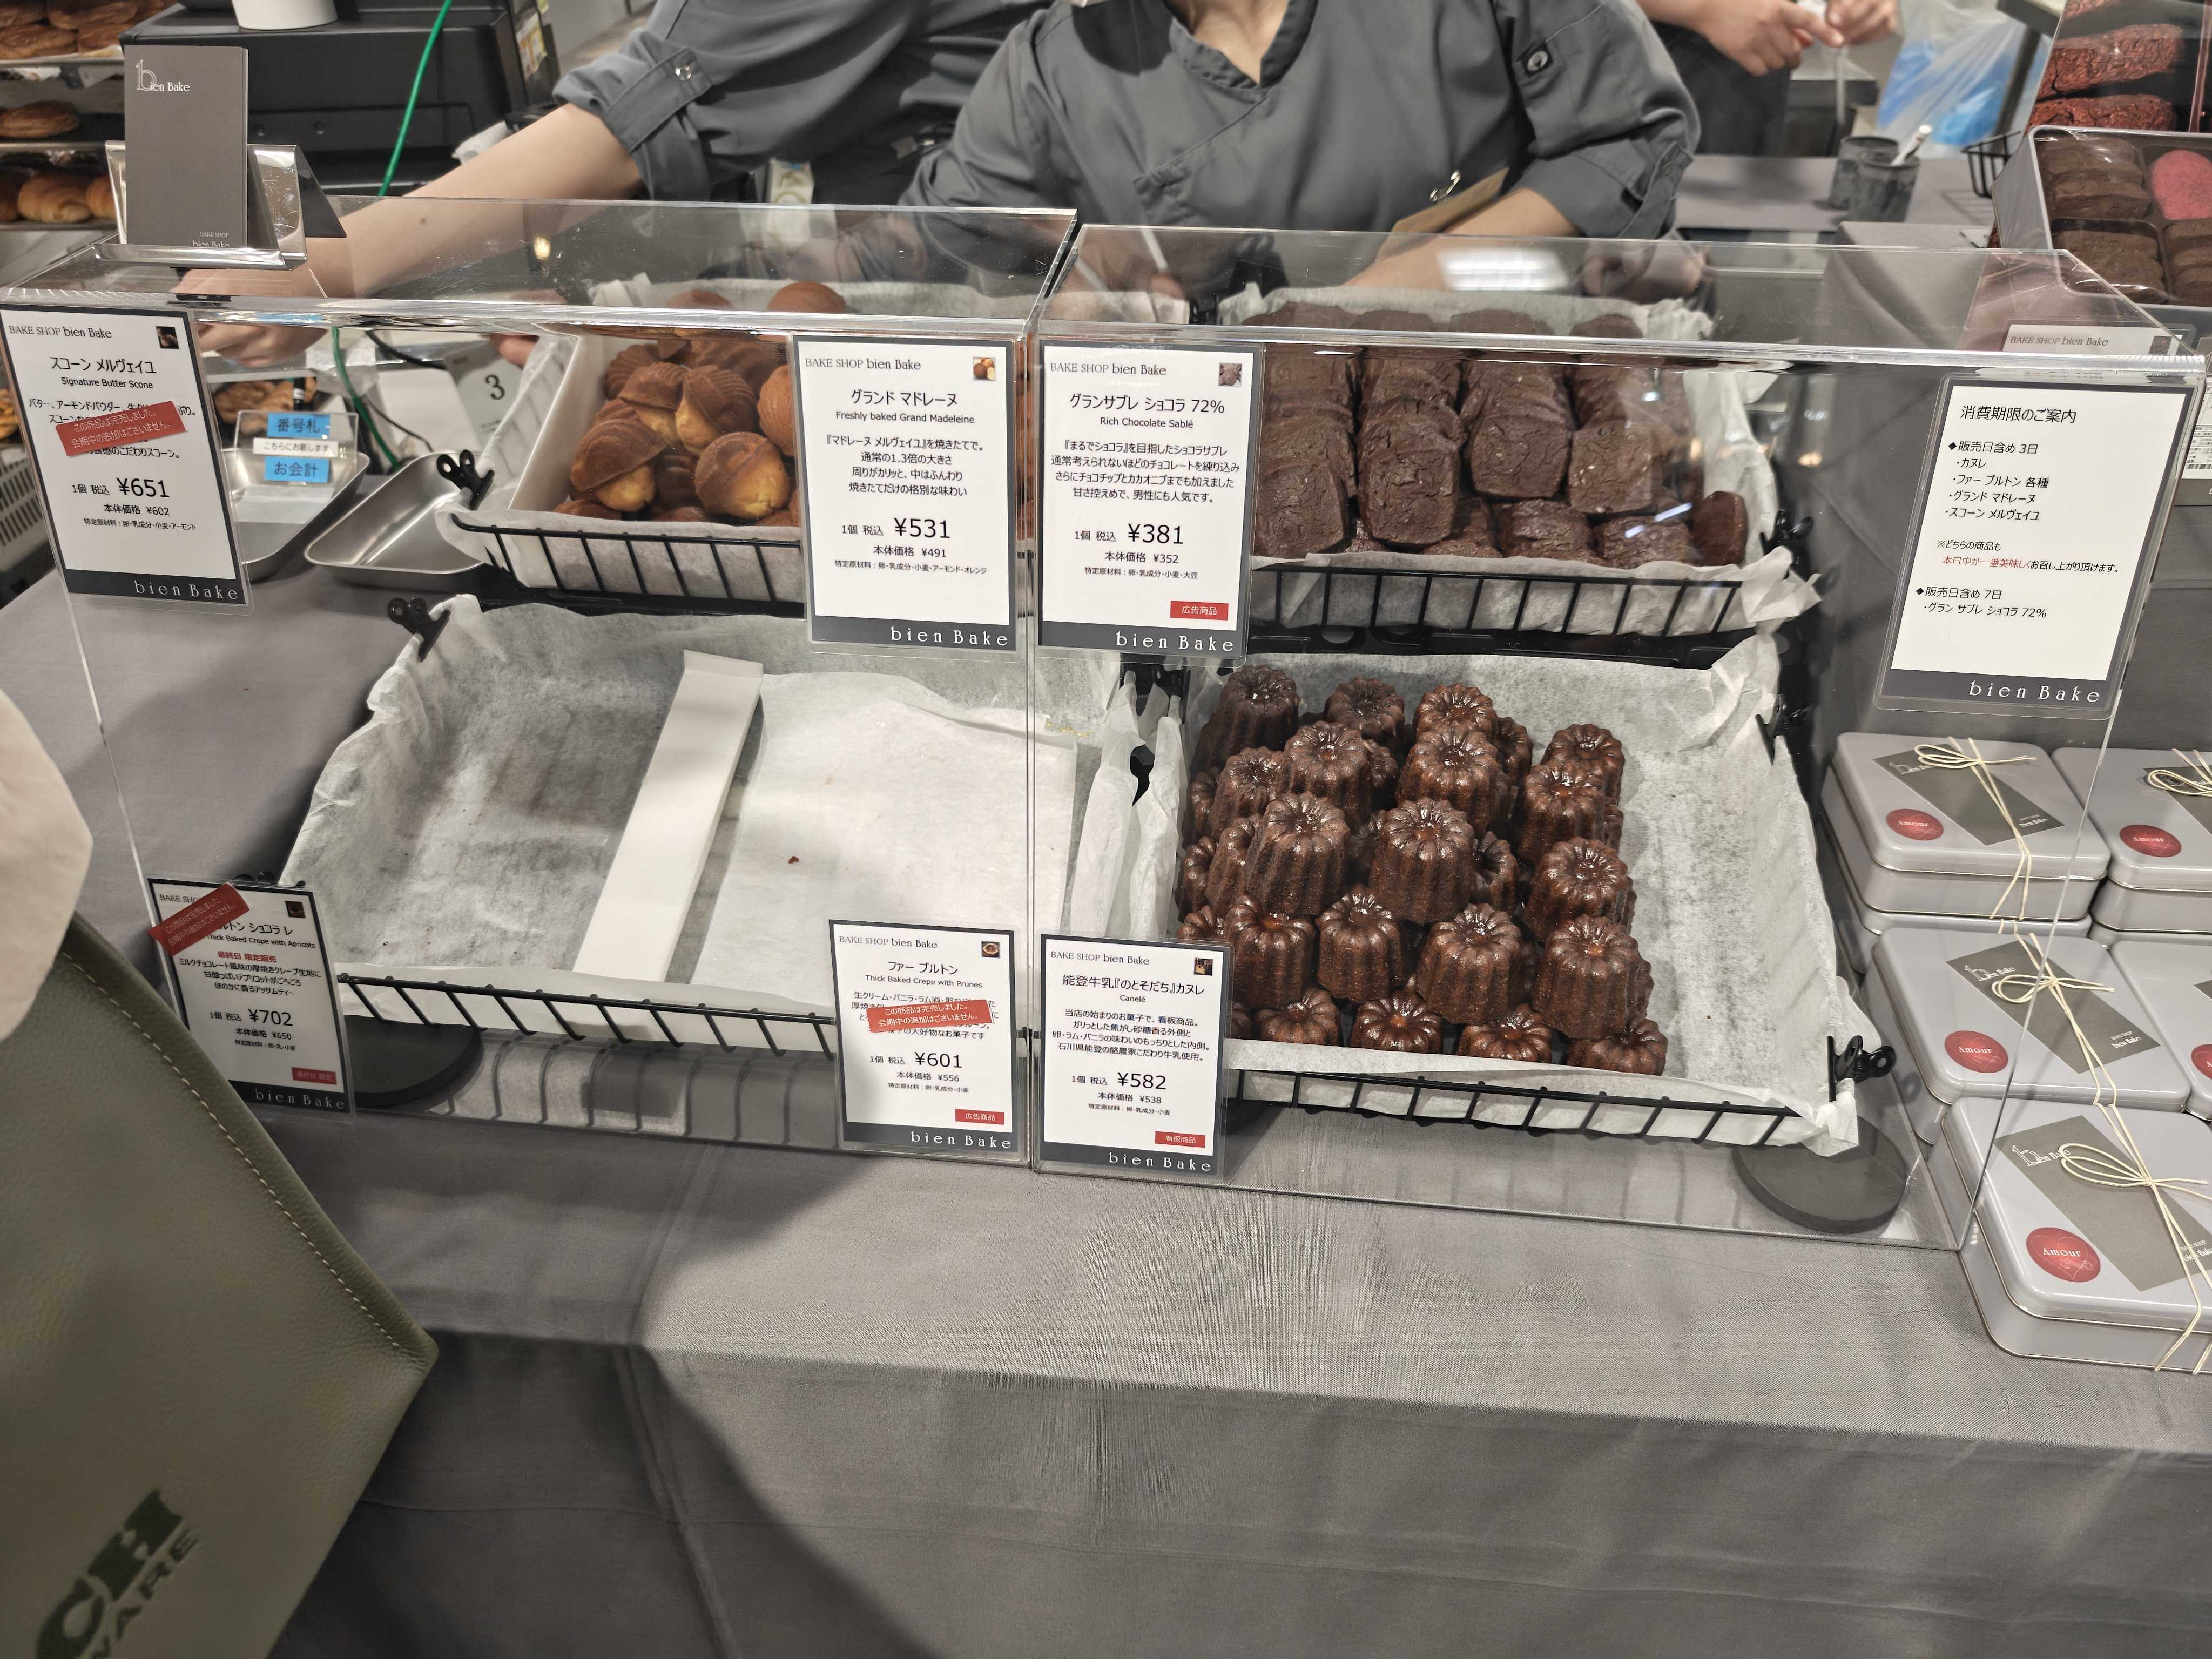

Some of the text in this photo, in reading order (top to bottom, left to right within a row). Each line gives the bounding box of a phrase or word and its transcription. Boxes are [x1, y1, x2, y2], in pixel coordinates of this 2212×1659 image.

[136, 60, 190, 91] bien Bake
[9, 326, 112, 338] BAKE SHOP bien Bake
[2062, 336, 2083, 346] bien
[2087, 338, 2108, 346] Bake
[50, 358, 157, 374] スコーン メルヴェイユ
[806, 359, 921, 370] BAKE SHOP bien Bake
[1051, 363, 1166, 375] BAKE SHOP bien Bake
[61, 378, 99, 387] Signature
[102, 380, 126, 388] Butter
[485, 375, 505, 400] 3
[851, 389, 958, 407] グランド マドレーヌ
[1070, 393, 1224, 413] グランサブレ ショコラ 72%
[73, 410, 156, 433] この商品は完売しました。
[836, 412, 974, 424] Freshly baked Grand Madeleine
[1961, 405, 2076, 424] 消費期限のご案内
[278, 419, 320, 433] 番号札
[1101, 417, 1193, 428] Rich Chocolate Sablé
[1064, 440, 1227, 456] 『まるでショコラ』を目指したショコラサブレ
[2019, 444, 2038, 454] 3日
[861, 452, 952, 465] 通常の1.3倍の大きさ
[1051, 455, 1239, 472] 通常考えられないほどのチョコレートを練り込み
[274, 462, 319, 477] お会計
[852, 467, 962, 481] 周りがカリッと、中はふんわり
[1055, 471, 1234, 488] さらにチョコチップとカカオニブまでも加えました
[1985, 476, 2049, 488] ブルトン 各種
[73, 478, 170, 497] 1個 税込 ¥651
[849, 483, 967, 497] 焼きたてだけの格別な味わい
[1073, 487, 1213, 503] 甘さ控えめで、男性にも人気です。
[1992, 493, 2035, 504] マドレーヌ
[104, 504, 170, 515] 本体価格 ¥602
[1988, 509, 2040, 521] メルヴェイユ
[842, 517, 950, 538] 1個 税込 ¥531
[1075, 523, 1183, 544] 1個 税込 ¥381
[873, 546, 946, 558] 本体価格 ¥491
[1105, 551, 1178, 563] 本体価格 ¥352
[133, 580, 238, 600] bien Bake
[1984, 590, 2001, 599] 7日
[1182, 606, 1217, 615] 広告商品
[1958, 604, 2047, 618] サブレ ショコラ 72%
[891, 626, 1007, 646] bien Bake
[1116, 631, 1233, 652] bien Bake
[1969, 680, 2100, 703] bien Bake
[159, 894, 181, 902] BAKE
[249, 922, 280, 935] ショコラ
[288, 940, 315, 948] Apricots
[892, 939, 912, 947] bien
[916, 940, 937, 948] Bake
[1051, 951, 1074, 959] BAKE
[1103, 954, 1123, 963] bien
[1128, 956, 1149, 965] Bake
[888, 961, 958, 975] ファー ブルトン
[1063, 974, 1204, 995] 能登牛乳『のとそだち』カヌレ
[885, 1003, 967, 1015] この商品は完売しました。
[248, 1009, 293, 1026] ¥702
[878, 1013, 979, 1027] 会期中の追加はございません。
[1065, 1009, 1198, 1026] 当店の始まりのお菓子で、看板商品。
[1958, 1046, 1992, 1055] Amour
[914, 1052, 962, 1068] ¥601
[896, 1072, 932, 1080] 本体価格
[1090, 1077, 1107, 1085] 税込
[1118, 1072, 1166, 1089] ¥582
[255, 1089, 344, 1109] bien Bake
[1098, 1092, 1161, 1104] 本体価格 ¥538
[911, 1131, 1011, 1148] bien Bake
[1166, 1135, 1196, 1144] 看板商品
[1109, 1152, 1210, 1171] bien Bake
[2043, 1247, 2080, 1258] Amour
